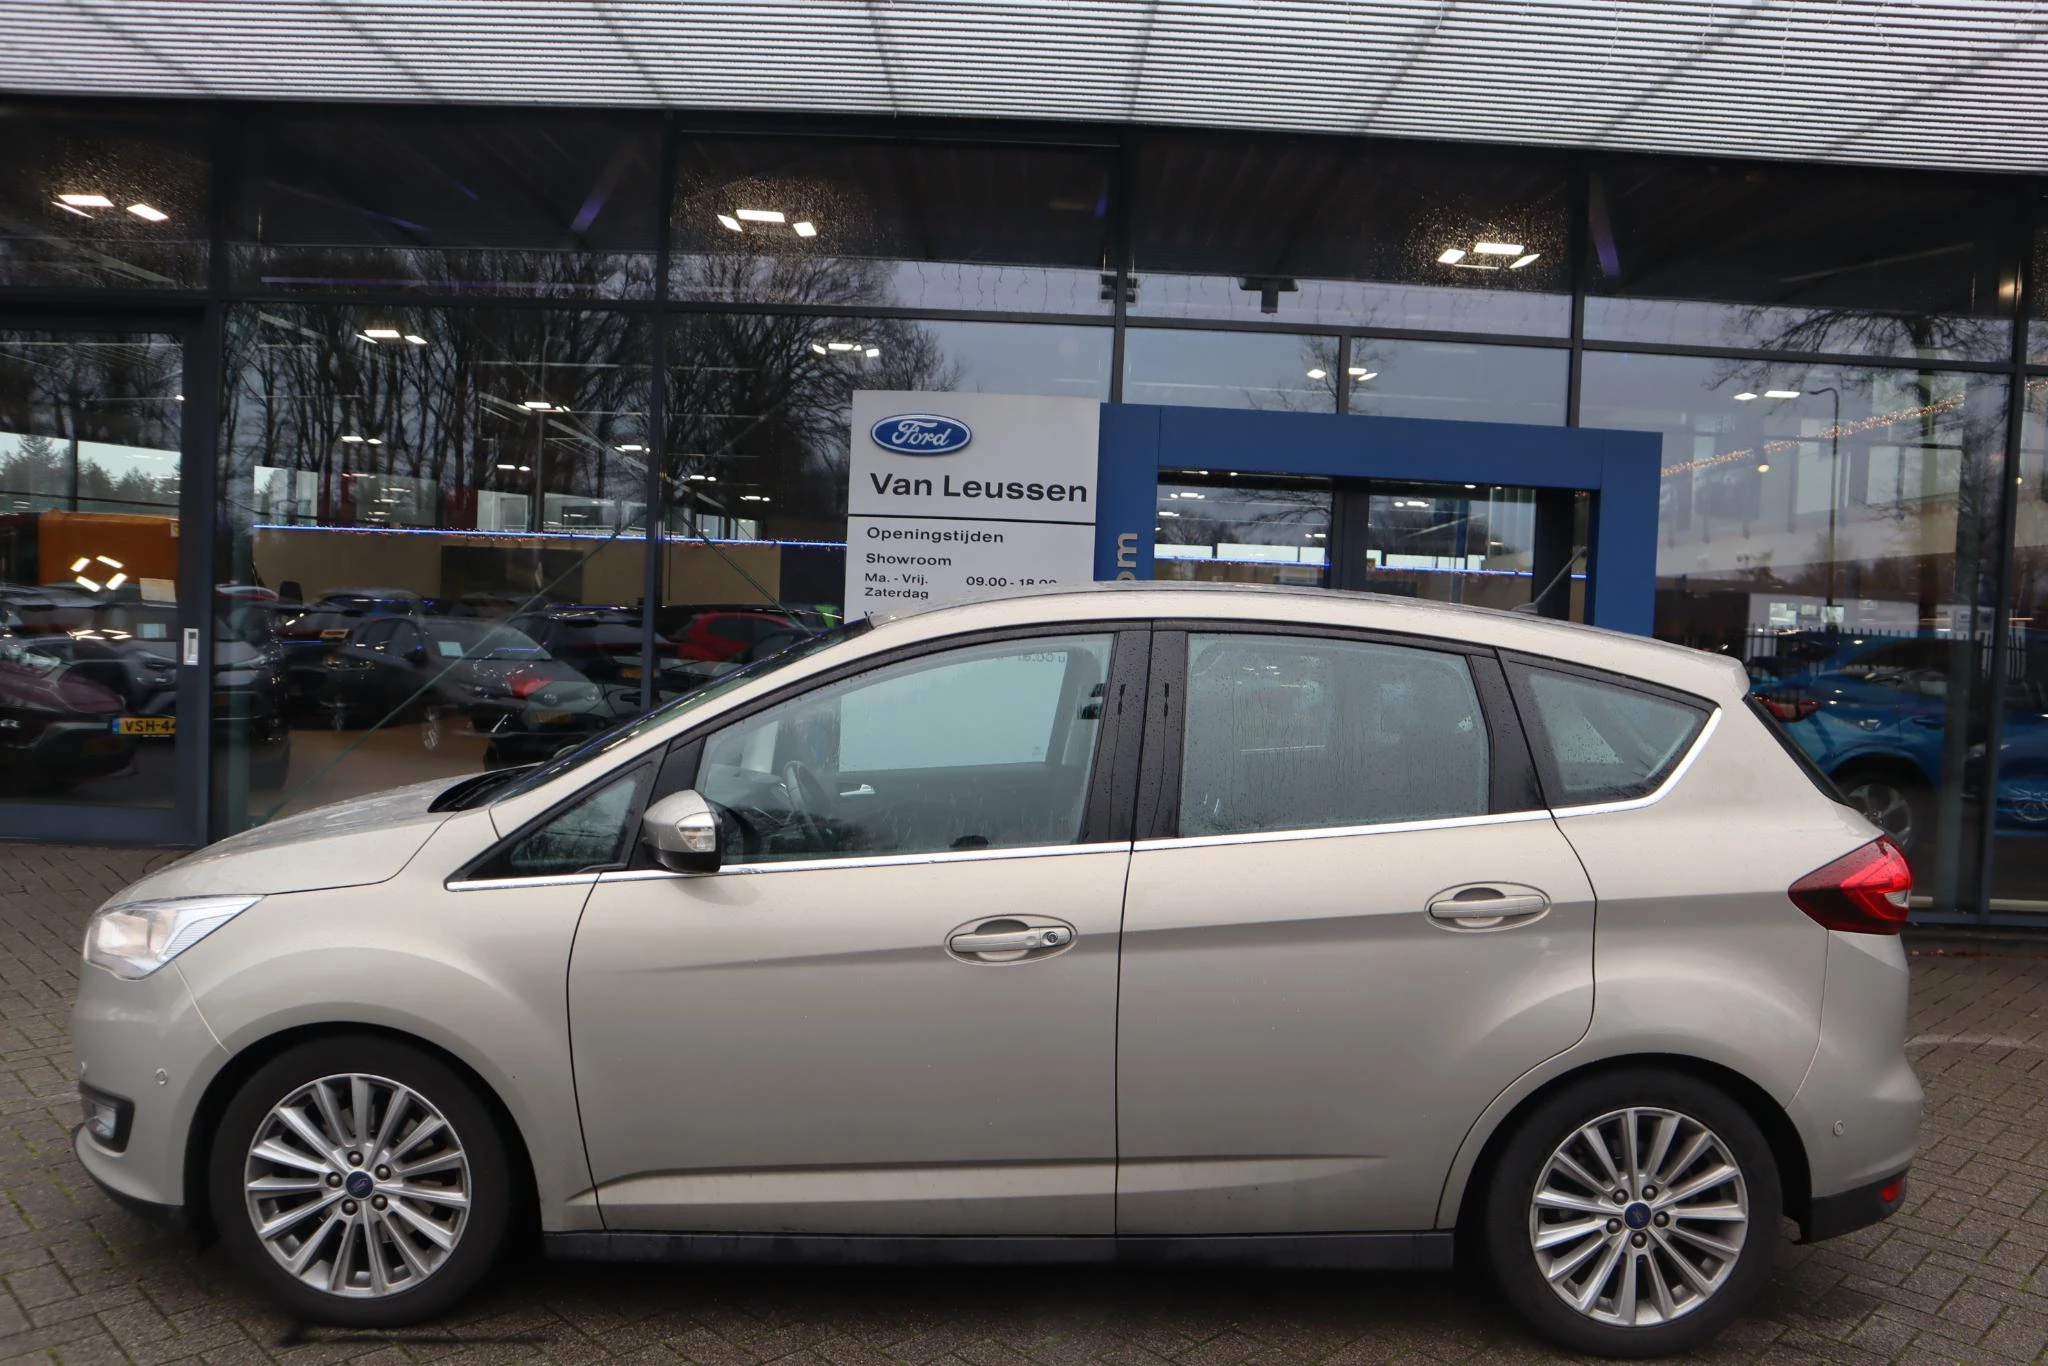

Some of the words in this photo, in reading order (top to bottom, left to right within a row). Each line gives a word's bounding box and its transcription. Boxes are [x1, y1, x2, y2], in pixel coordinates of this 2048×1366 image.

[891, 419, 952, 447] Ford
[870, 473, 933, 497] Van
[943, 475, 1088, 503] Leussen
[866, 526, 1005, 544] Openingstijden
[865, 552, 953, 567] Showroom
[864, 572, 891, 583] Ma.
[901, 573, 929, 586] Vrij.
[965, 576, 1007, 587] 09.00
[864, 586, 930, 601] Zaterdag
